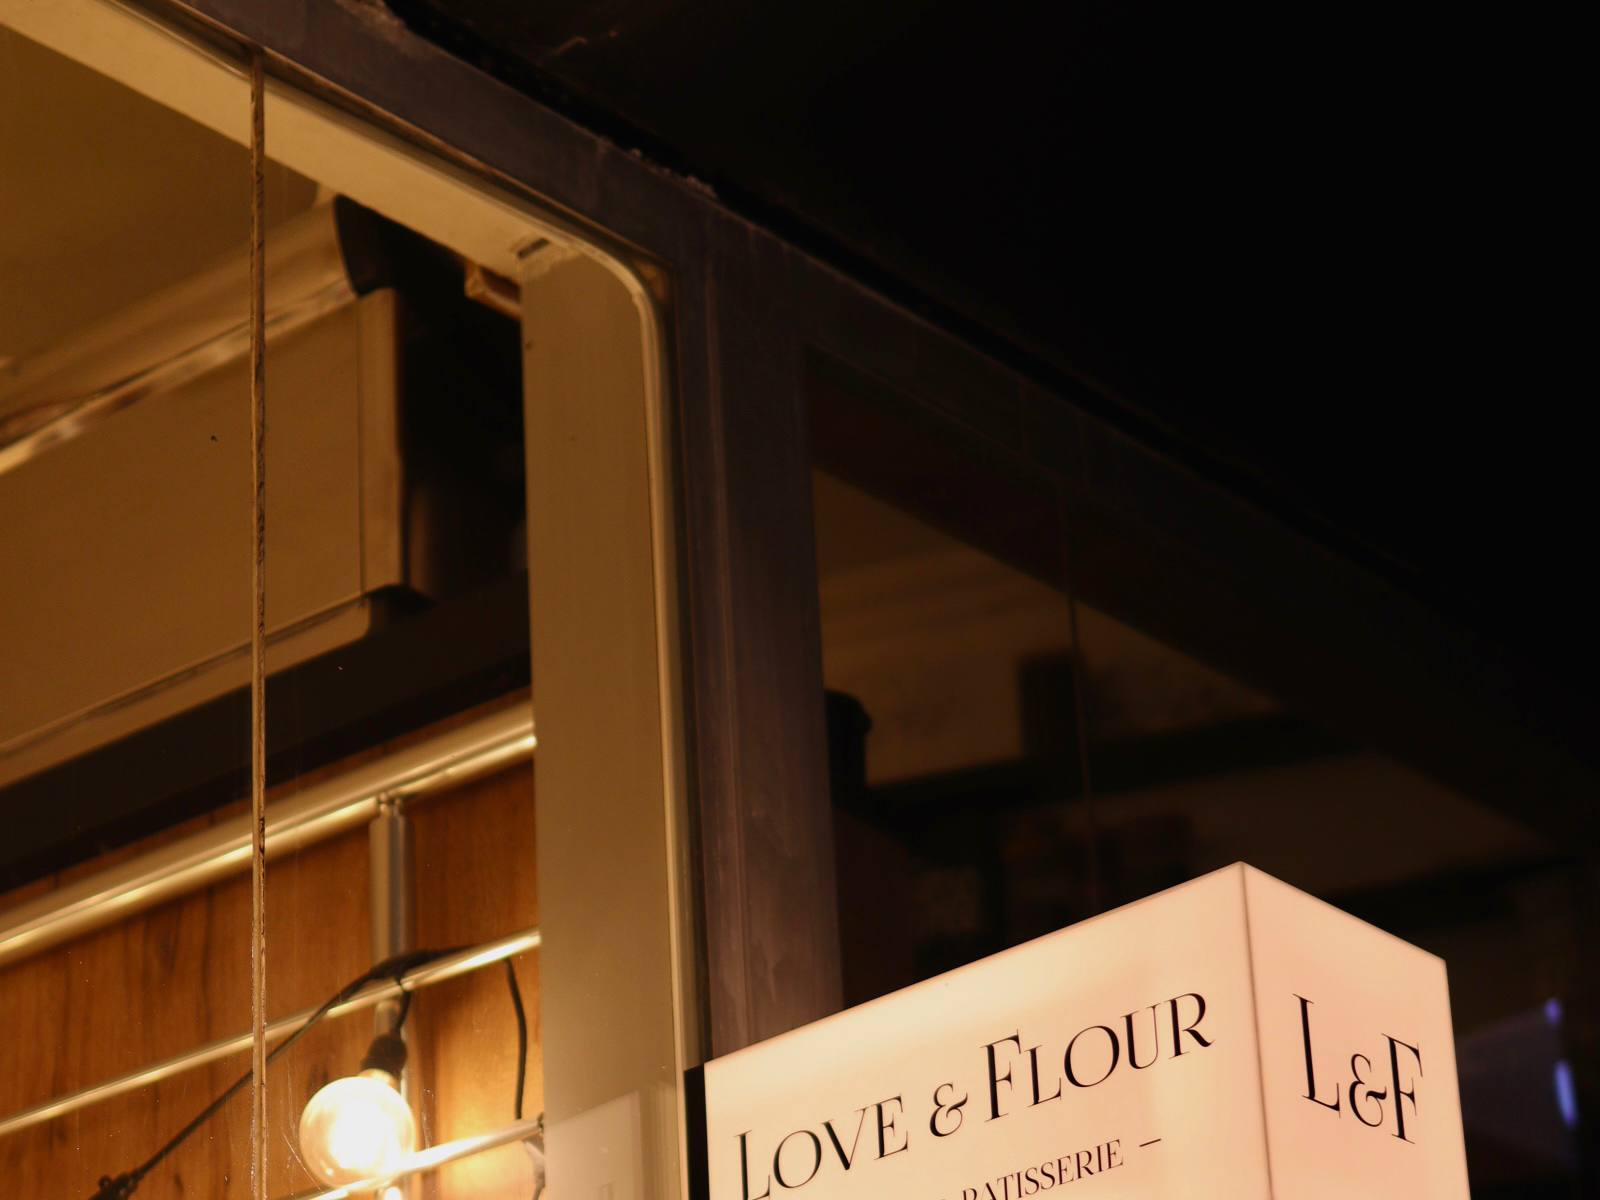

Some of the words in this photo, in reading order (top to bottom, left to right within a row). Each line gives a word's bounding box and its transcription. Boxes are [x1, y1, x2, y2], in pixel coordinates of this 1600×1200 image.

[929, 1082, 968, 1137] &
[979, 992, 1215, 1123] FLOUR
[1292, 993, 1423, 1144] L&F
